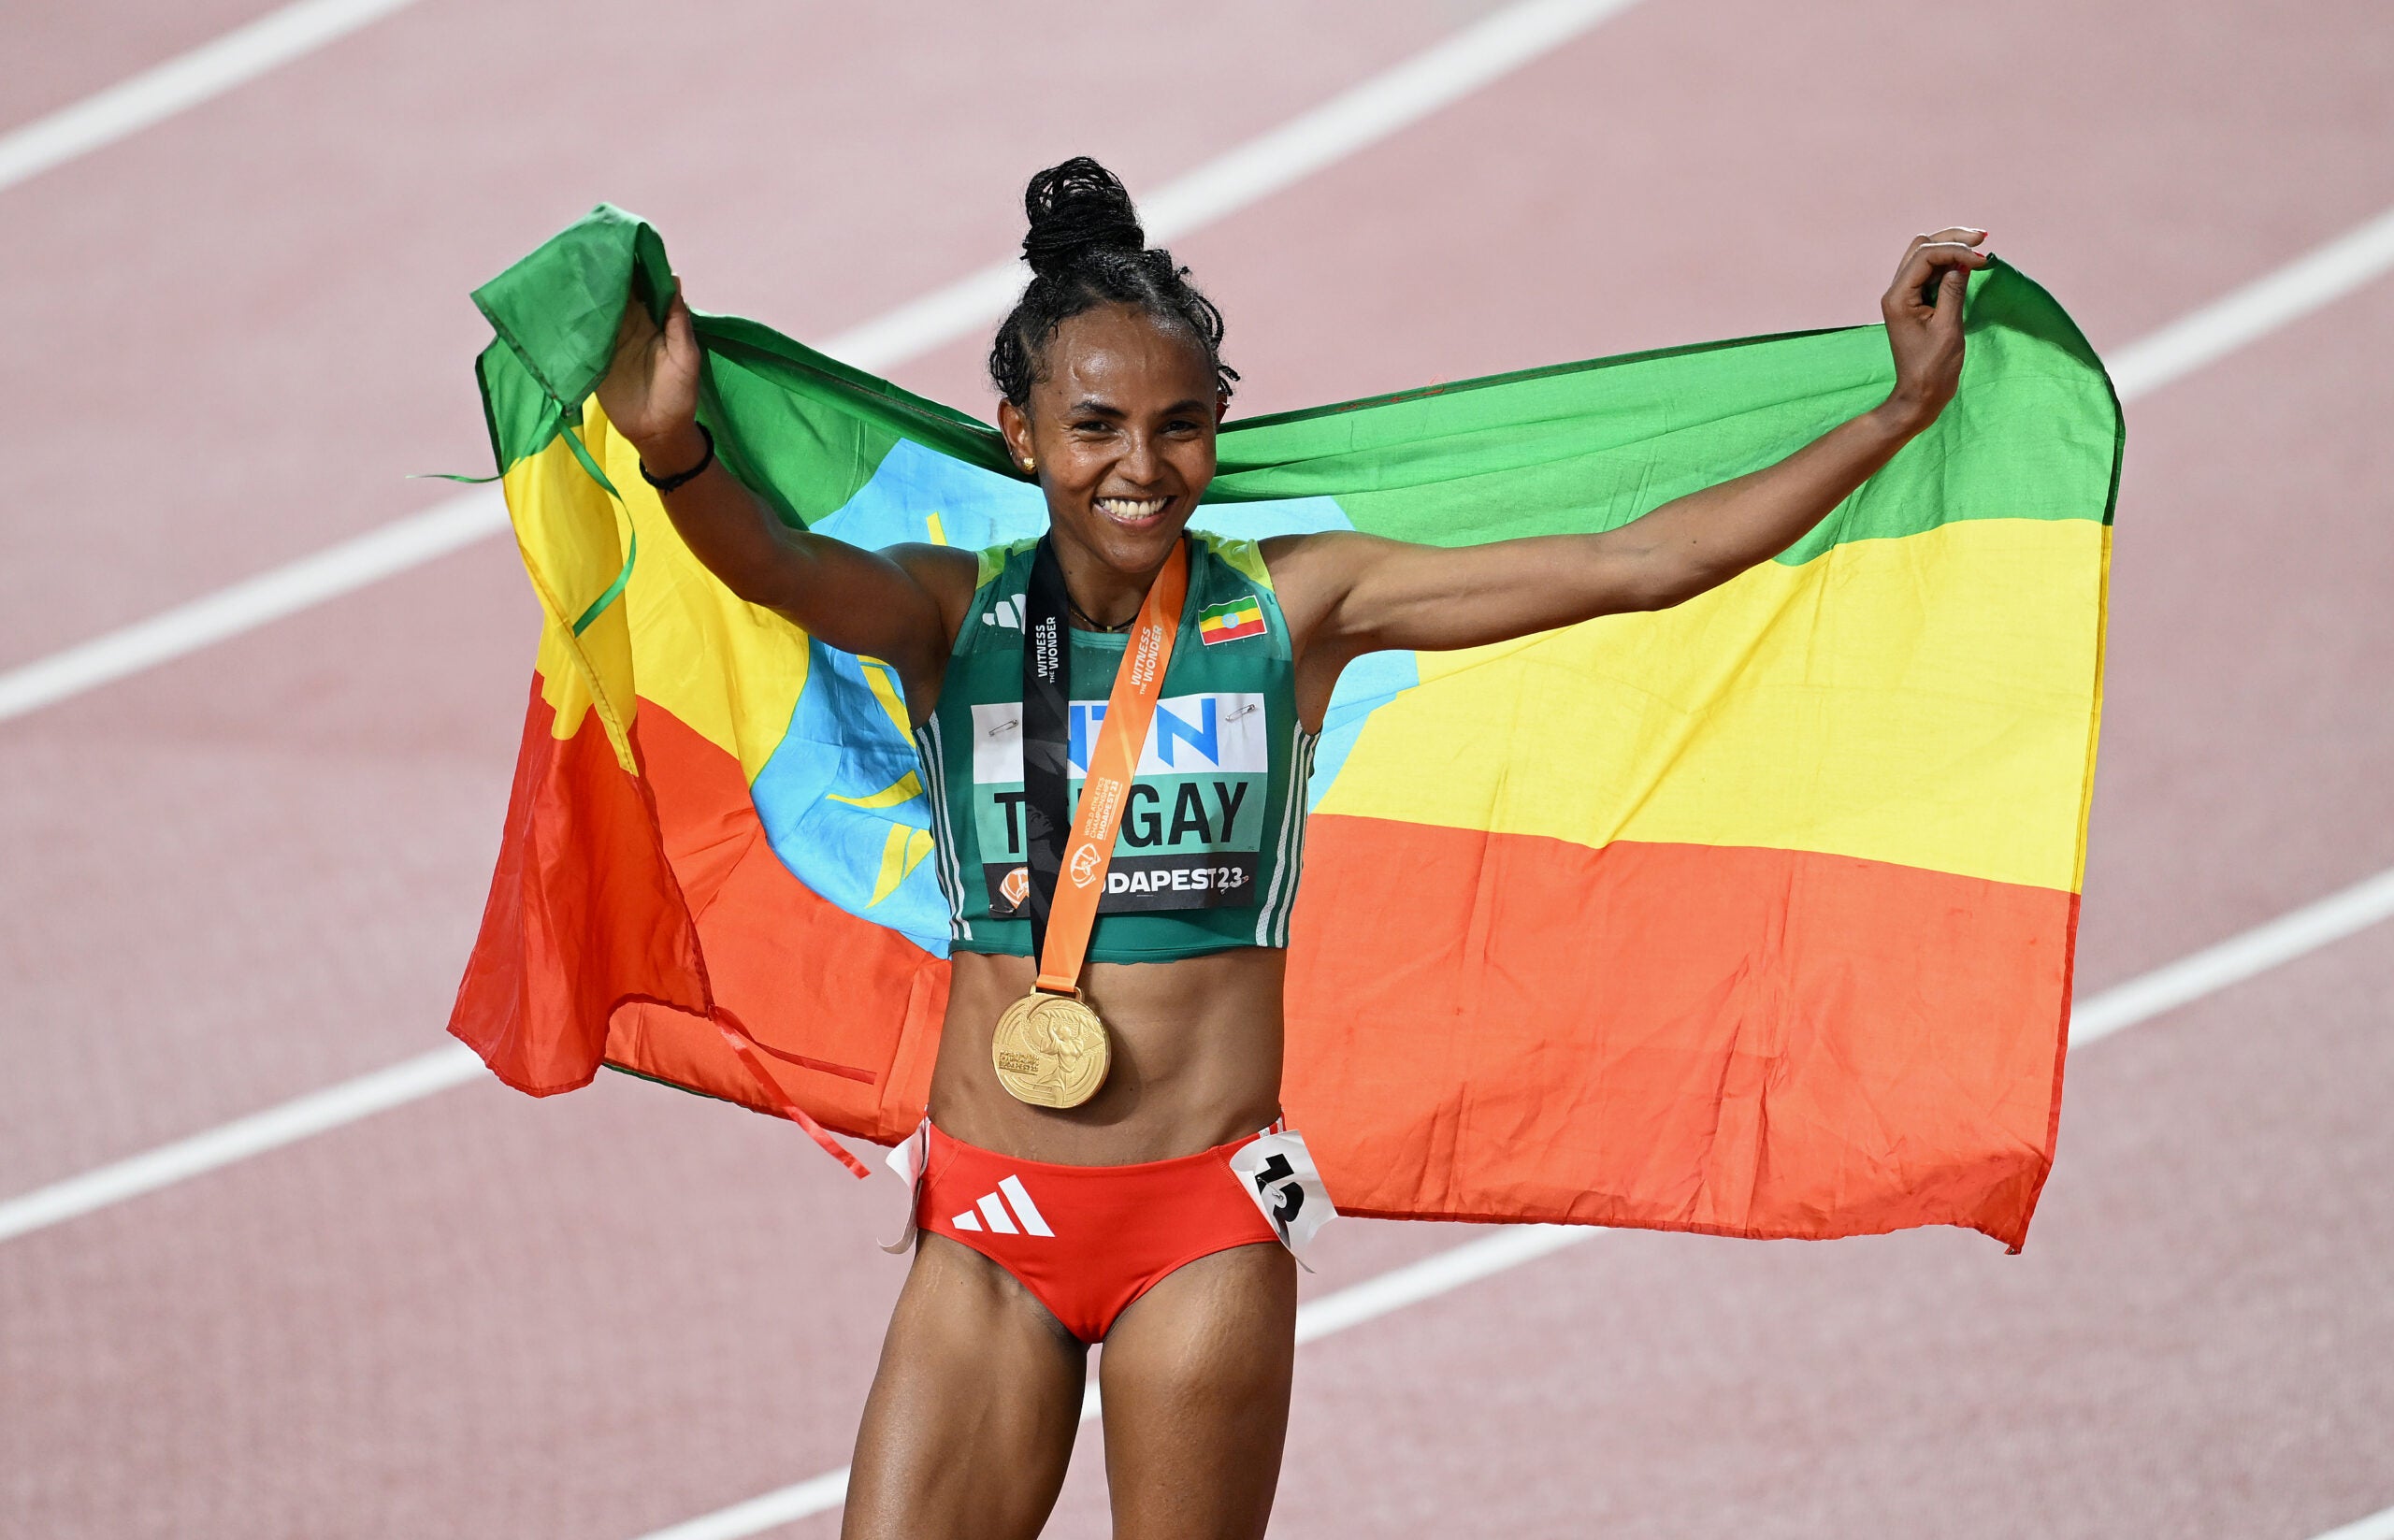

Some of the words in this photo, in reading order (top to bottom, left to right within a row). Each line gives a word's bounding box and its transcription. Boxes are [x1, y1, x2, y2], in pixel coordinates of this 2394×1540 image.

[1035, 624, 1048, 678] WITNESS
[1046, 616, 1059, 669] WONDER
[1131, 626, 1151, 686] WITNESS
[1139, 683, 1147, 695] THE
[1143, 624, 1162, 683] WONDER
[993, 782, 1249, 855] TGAY
[1084, 813, 1093, 836] WORLD
[1090, 777, 1104, 812] ATHLETICS
[1089, 778, 1111, 838] CHAMPIONSHIPS
[1097, 791, 1115, 840] BUDAPEST
[1102, 867, 1242, 893] DAPEST23
